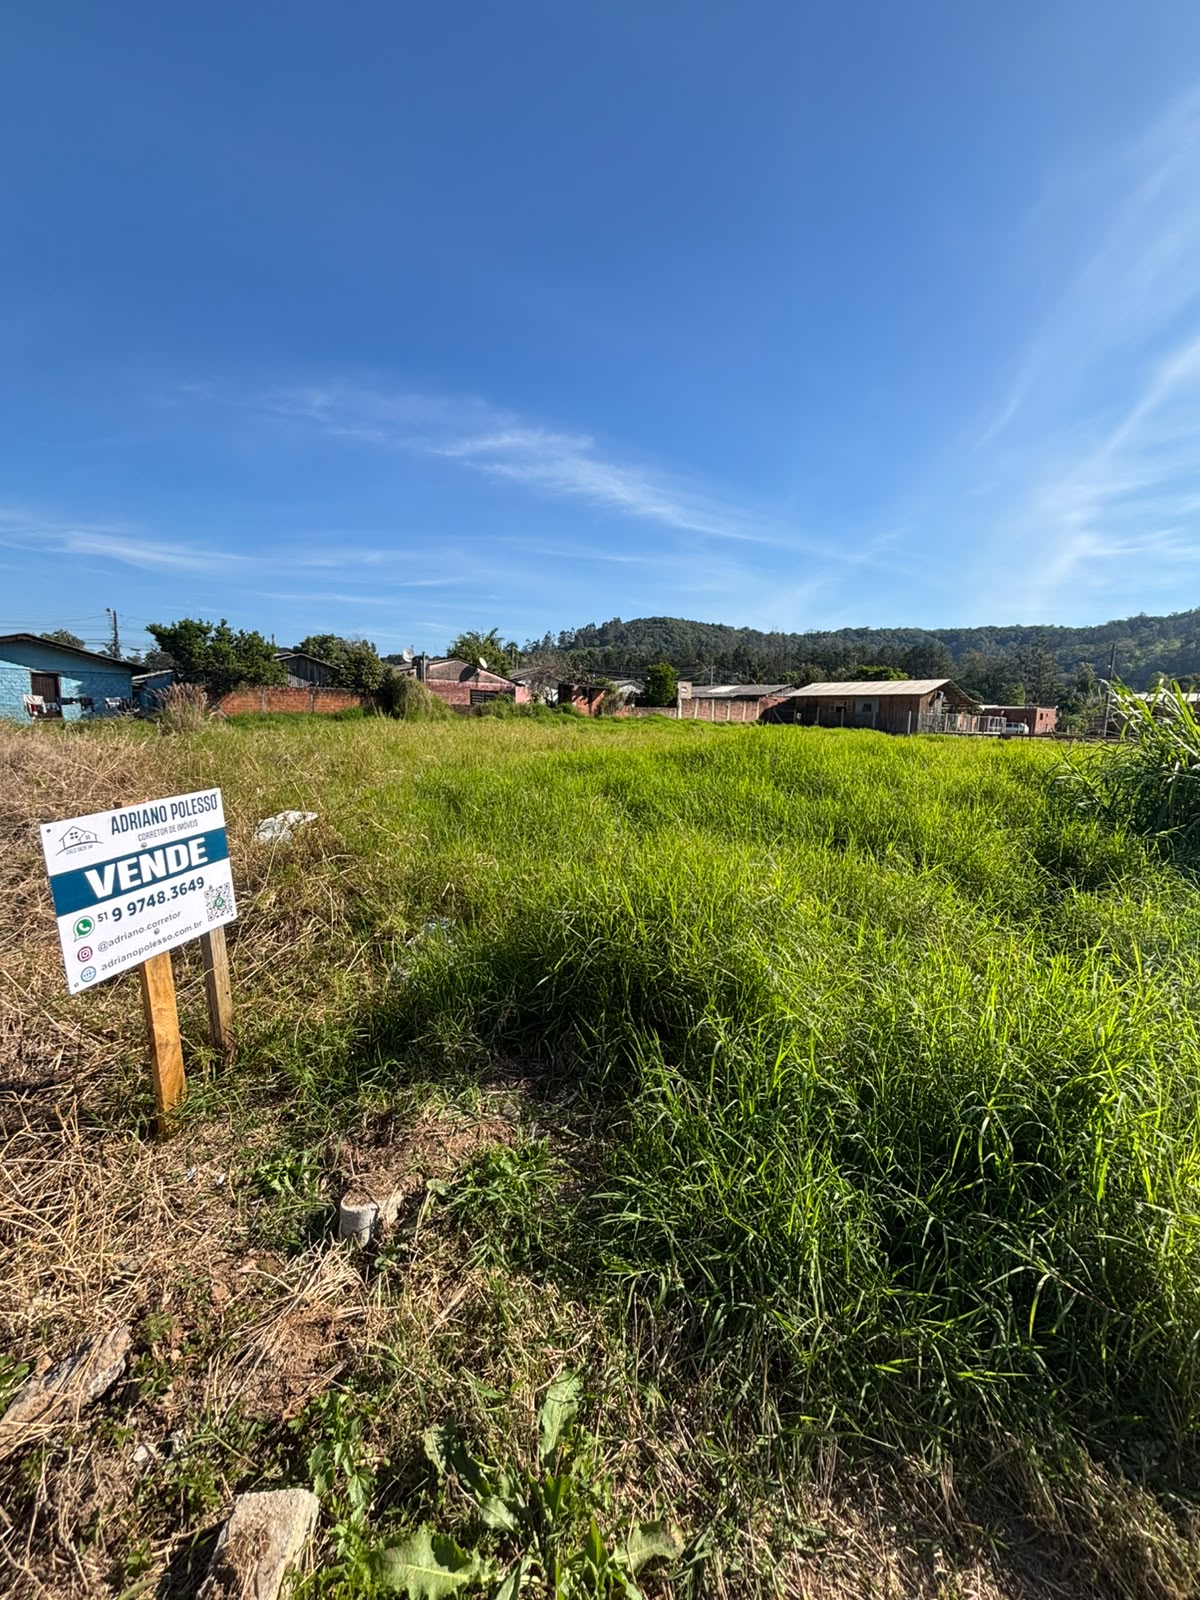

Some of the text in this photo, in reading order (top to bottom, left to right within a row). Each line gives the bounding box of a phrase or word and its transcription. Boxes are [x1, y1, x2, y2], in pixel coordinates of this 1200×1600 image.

[111, 794, 218, 835] ADRIANO POLESSO
[137, 819, 198, 842] CORRETOR DE IMÓVEIS
[84, 837, 208, 899] VENDE
[97, 876, 205, 923] 51 9 9748.3649
[97, 910, 182, 953] @adriano.corretor
[101, 920, 202, 972] adrianopolesso.com.br
